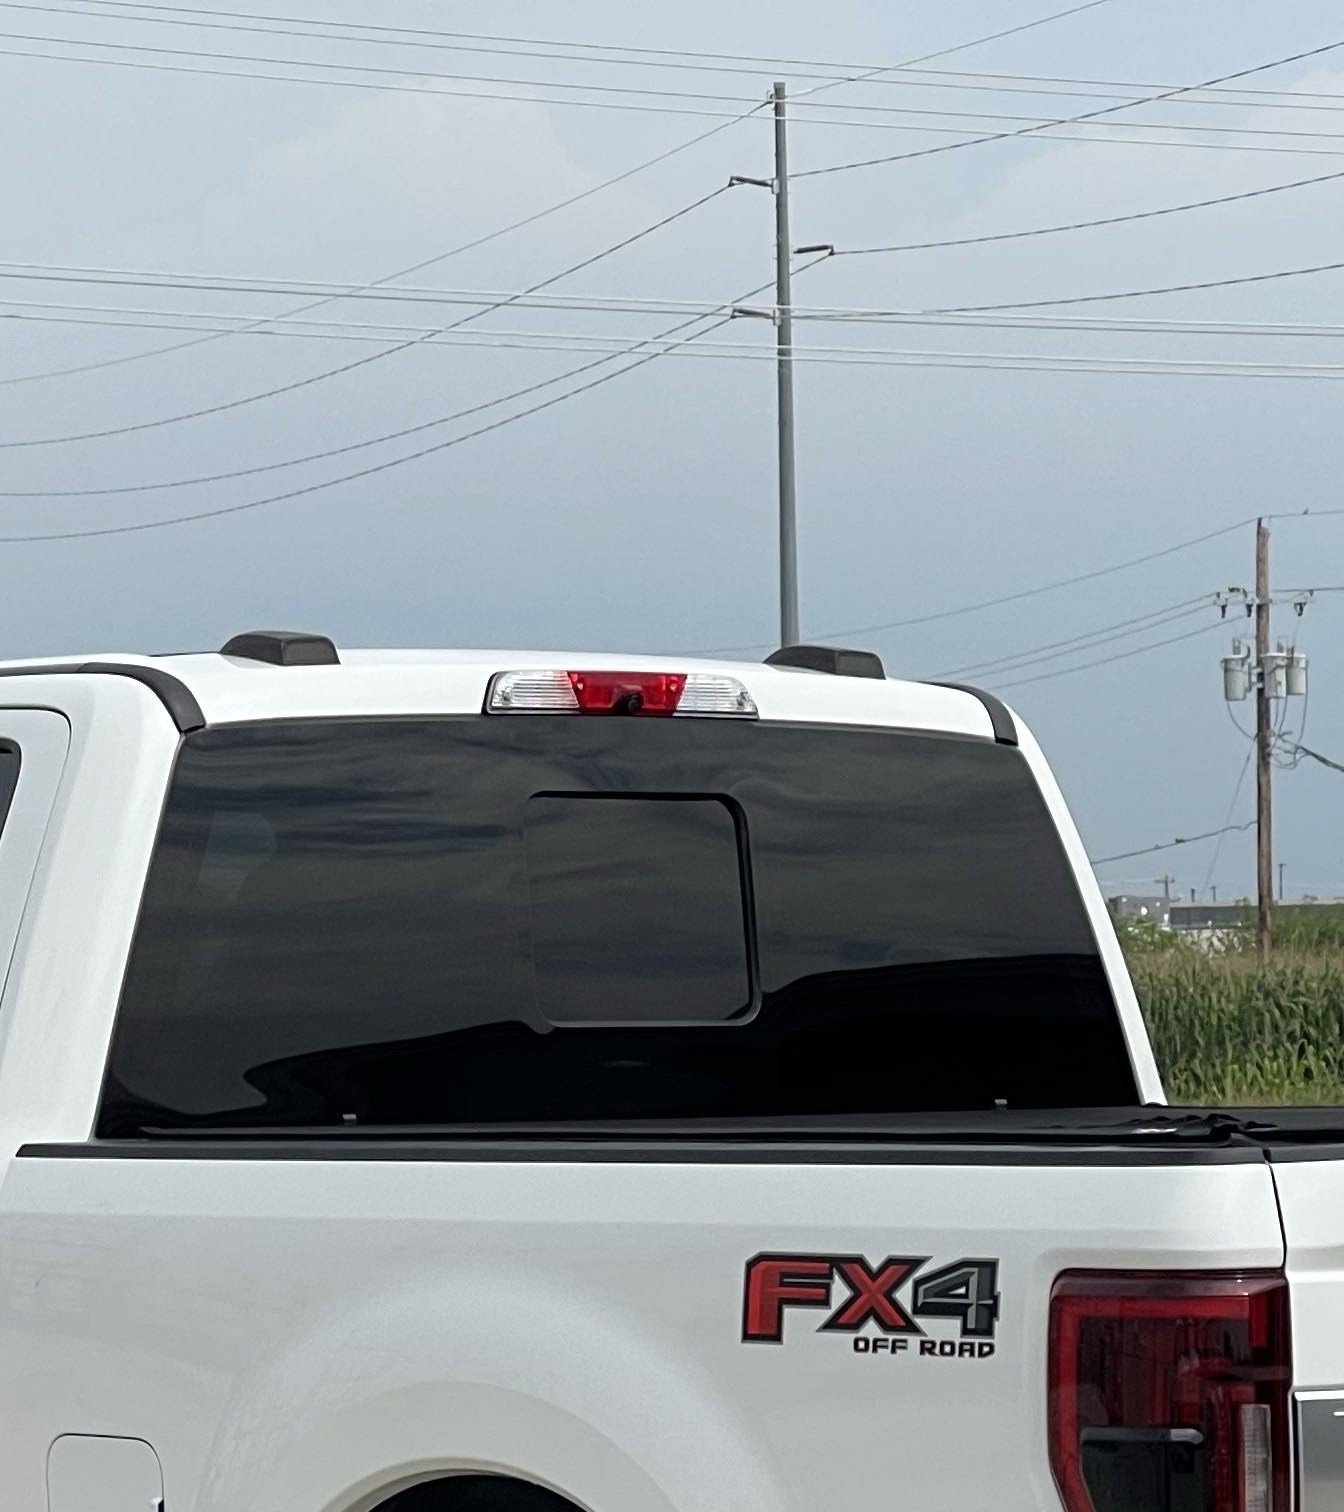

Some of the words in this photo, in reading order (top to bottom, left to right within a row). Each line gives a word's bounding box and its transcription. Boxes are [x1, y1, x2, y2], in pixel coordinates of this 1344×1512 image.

[741, 1251, 1001, 1345] FX4
[853, 1336, 908, 1355] OFF
[919, 1338, 996, 1359] ROAD
